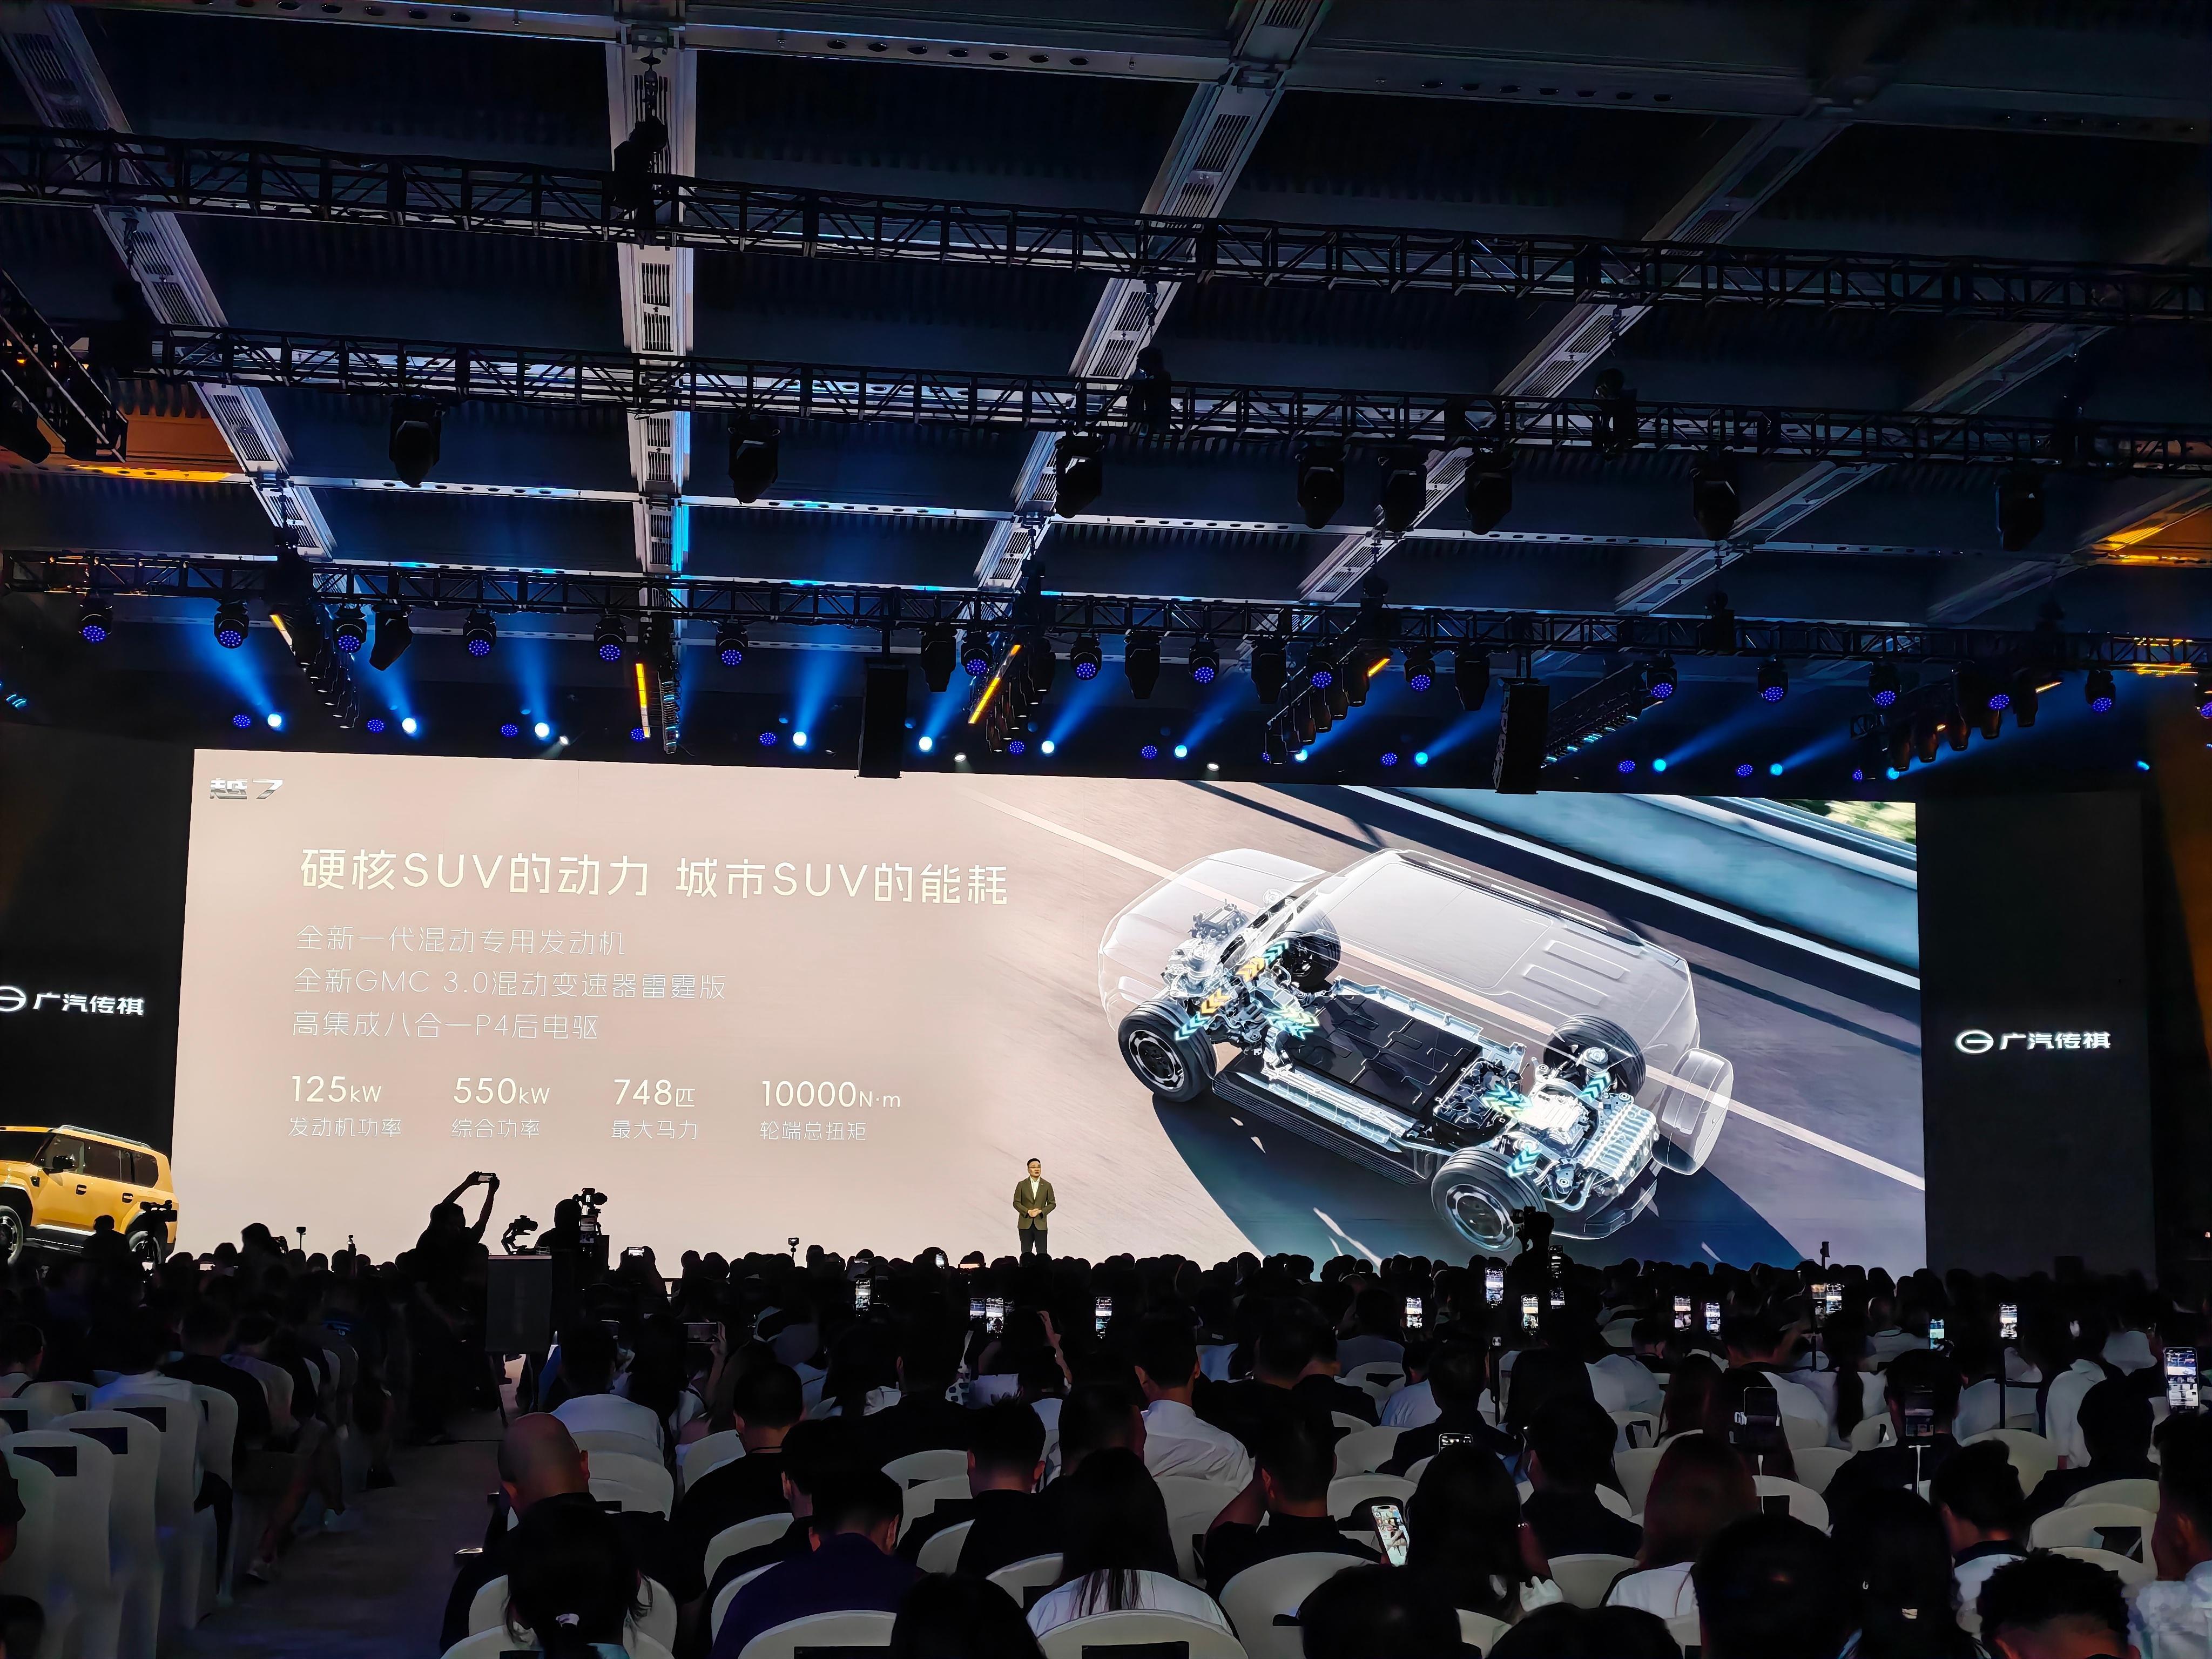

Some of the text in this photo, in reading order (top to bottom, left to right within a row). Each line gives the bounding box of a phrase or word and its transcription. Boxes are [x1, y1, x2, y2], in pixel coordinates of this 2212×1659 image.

[300, 848, 1008, 905] 硬核SUV的动力 城市SUV的能耗
[296, 925, 625, 955] 全新一代混动专用发动机
[294, 967, 727, 1000] 全新GMC 3.0混动变速器雷霆版
[33, 992, 145, 1016] 广汽传祺
[292, 1010, 599, 1040] 高集成八合一P4后电驱
[1999, 1031, 2111, 1050] 广汽传祺
[292, 1075, 382, 1103] 125kW
[453, 1077, 550, 1105] 550kW
[613, 1078, 696, 1108] 748匹
[288, 1116, 402, 1137] 发动机功率
[450, 1118, 541, 1139] 综合功率
[611, 1120, 697, 1140] 最大马力
[759, 1121, 867, 1141] 轮端总扭矩
